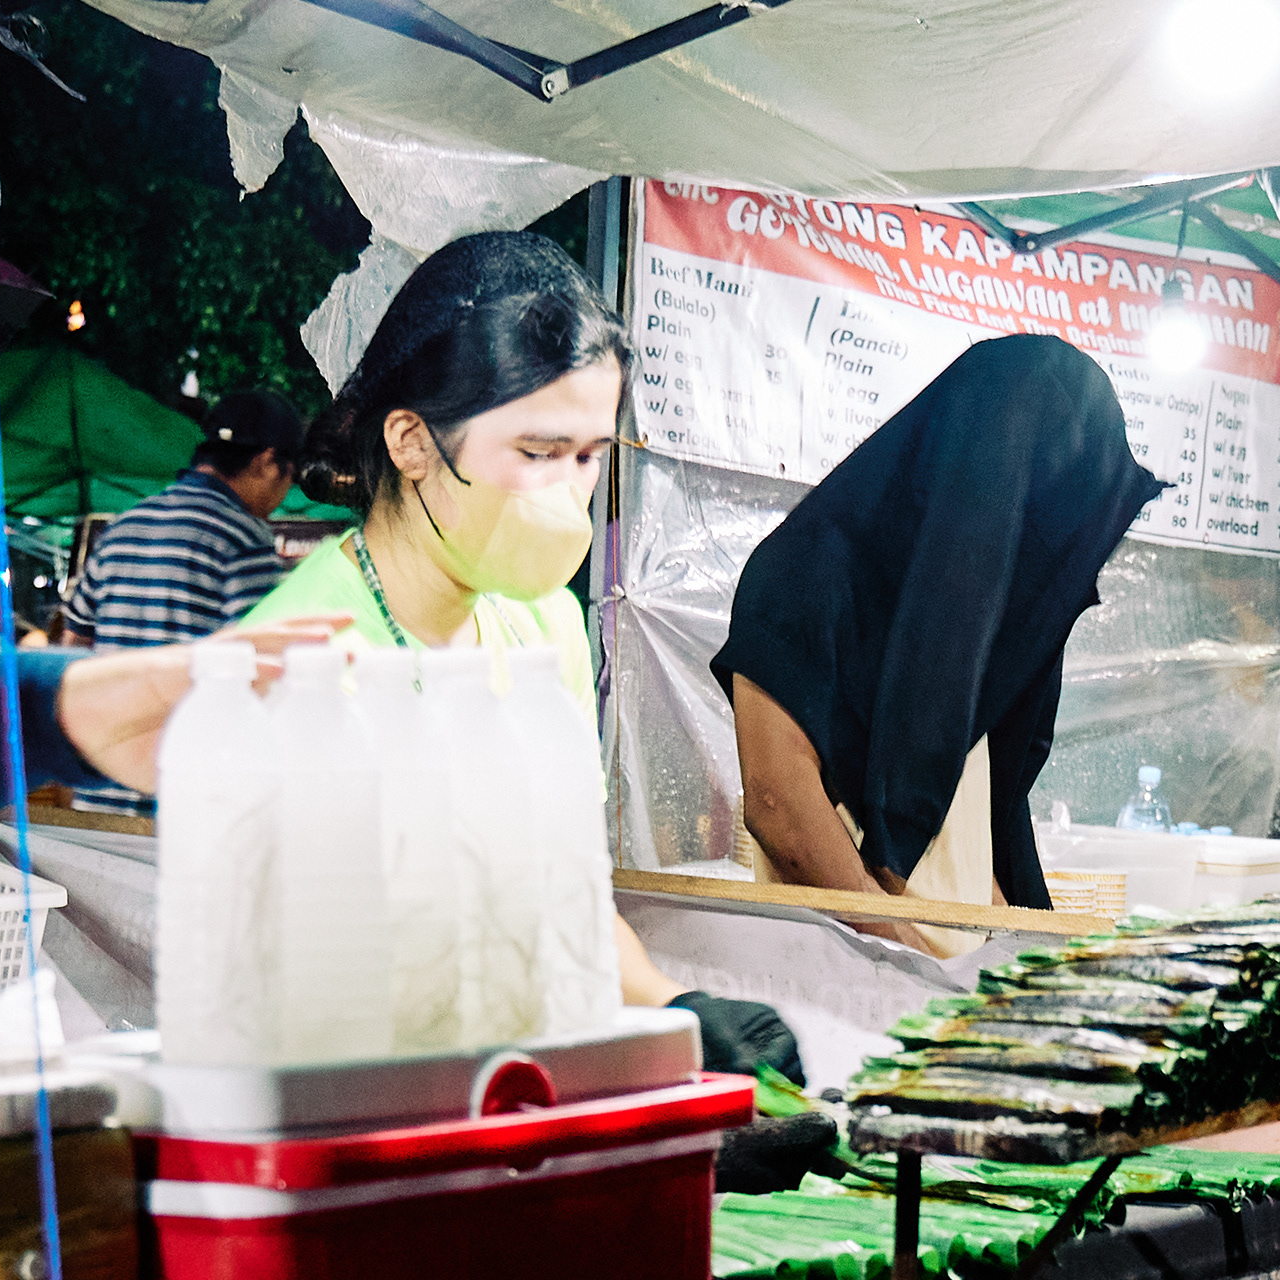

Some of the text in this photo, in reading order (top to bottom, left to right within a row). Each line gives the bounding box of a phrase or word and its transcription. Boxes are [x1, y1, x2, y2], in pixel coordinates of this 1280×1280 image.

[653, 288, 716, 323] (Bulalo)
[900, 257, 1072, 323] LUGAWAN
[1079, 296, 1112, 328] at
[646, 313, 692, 341] Plain
[830, 328, 909, 361] (Pancit)
